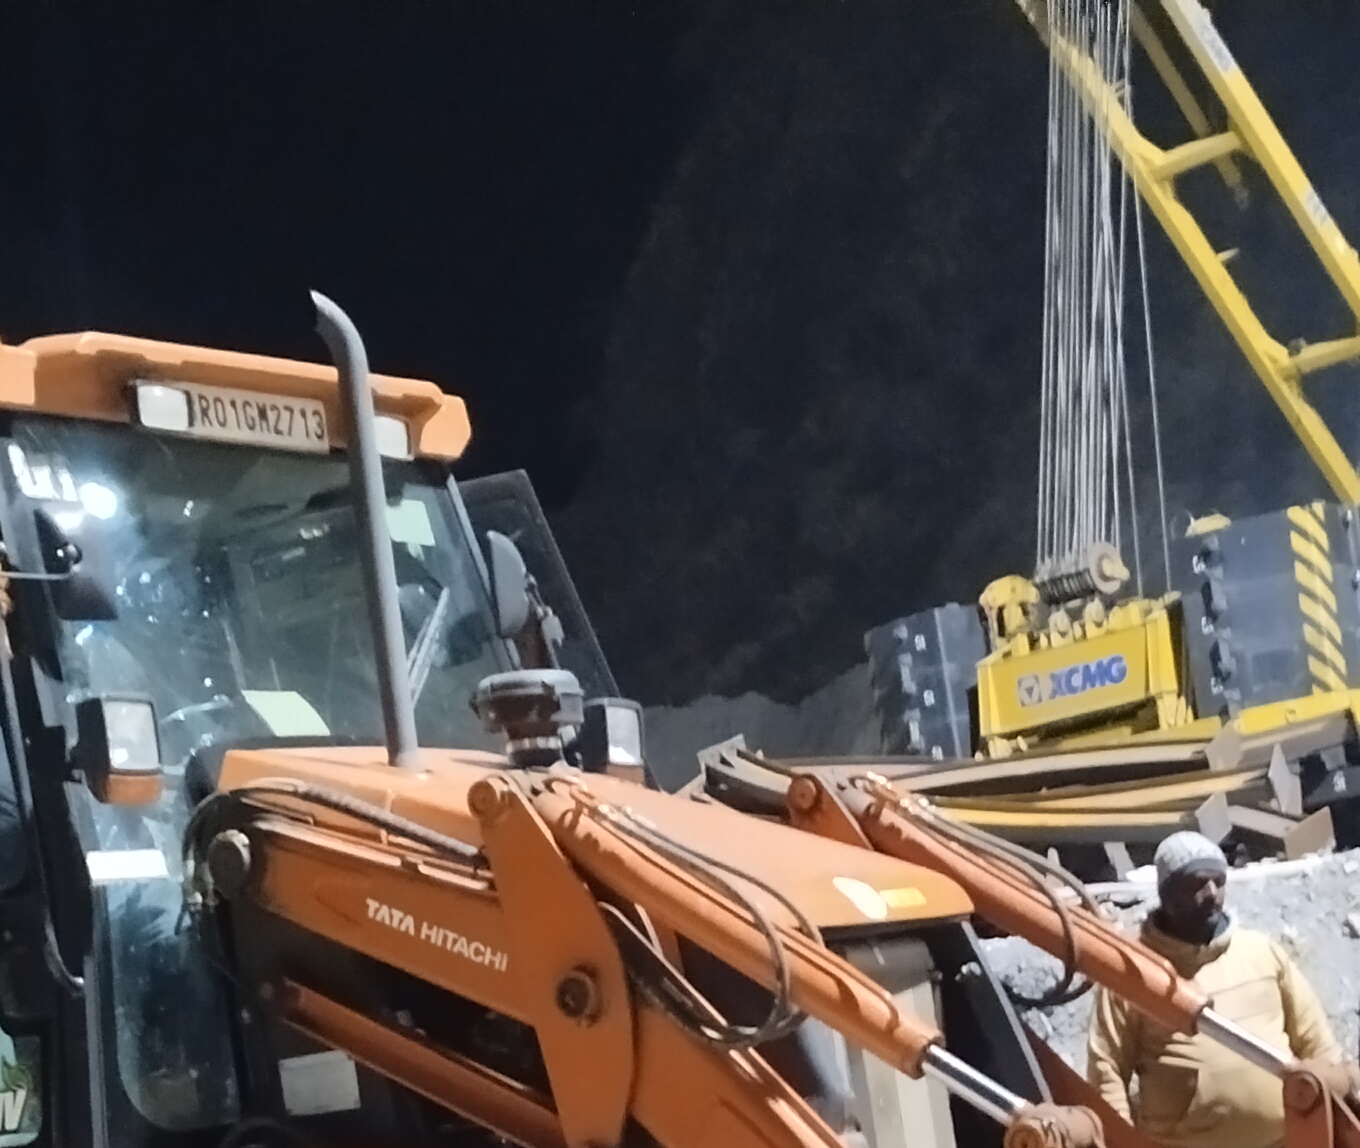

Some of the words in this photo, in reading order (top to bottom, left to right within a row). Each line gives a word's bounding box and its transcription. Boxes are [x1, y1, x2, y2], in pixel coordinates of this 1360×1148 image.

[1048, 655, 1128, 700] XCMG
[366, 898, 415, 936] TATA
[420, 921, 508, 972] HITACHI
